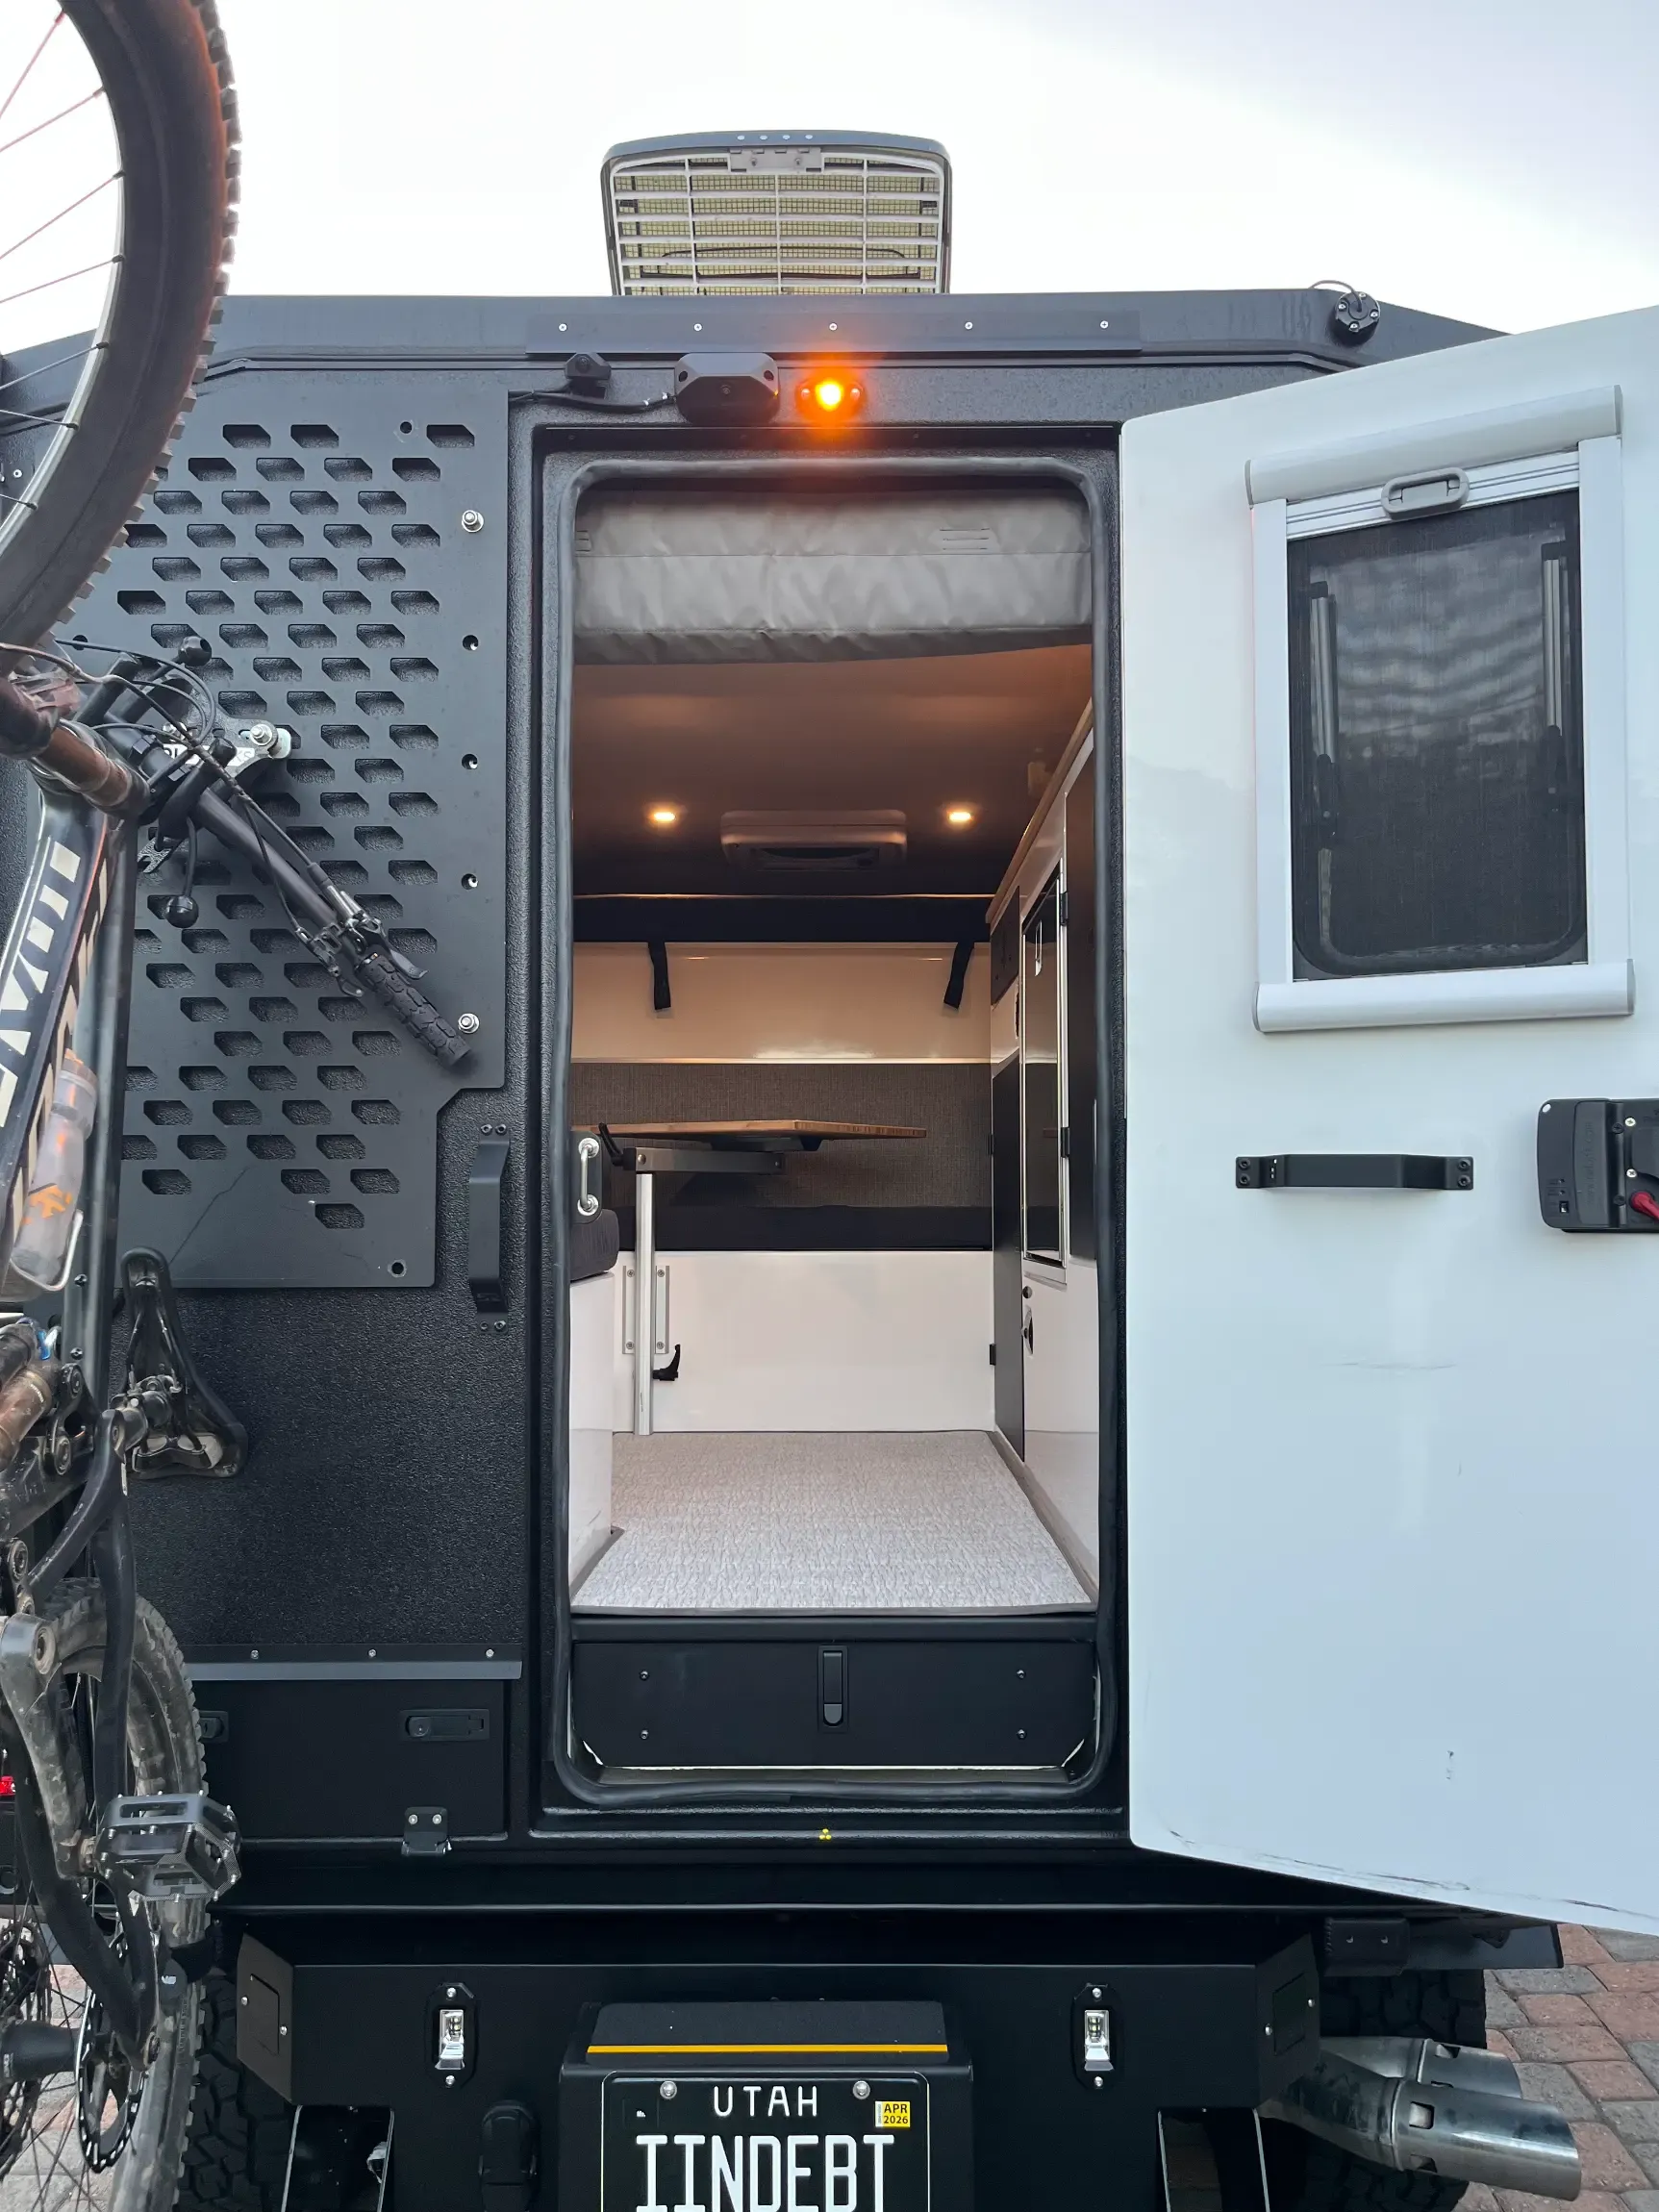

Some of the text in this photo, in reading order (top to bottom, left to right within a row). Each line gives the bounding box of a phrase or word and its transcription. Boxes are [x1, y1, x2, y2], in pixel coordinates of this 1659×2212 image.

[714, 2085, 817, 2117] UTAH
[884, 2103, 908, 2114] APR
[884, 2116, 909, 2124] 2026
[636, 2134, 894, 2212] IINDEBT
